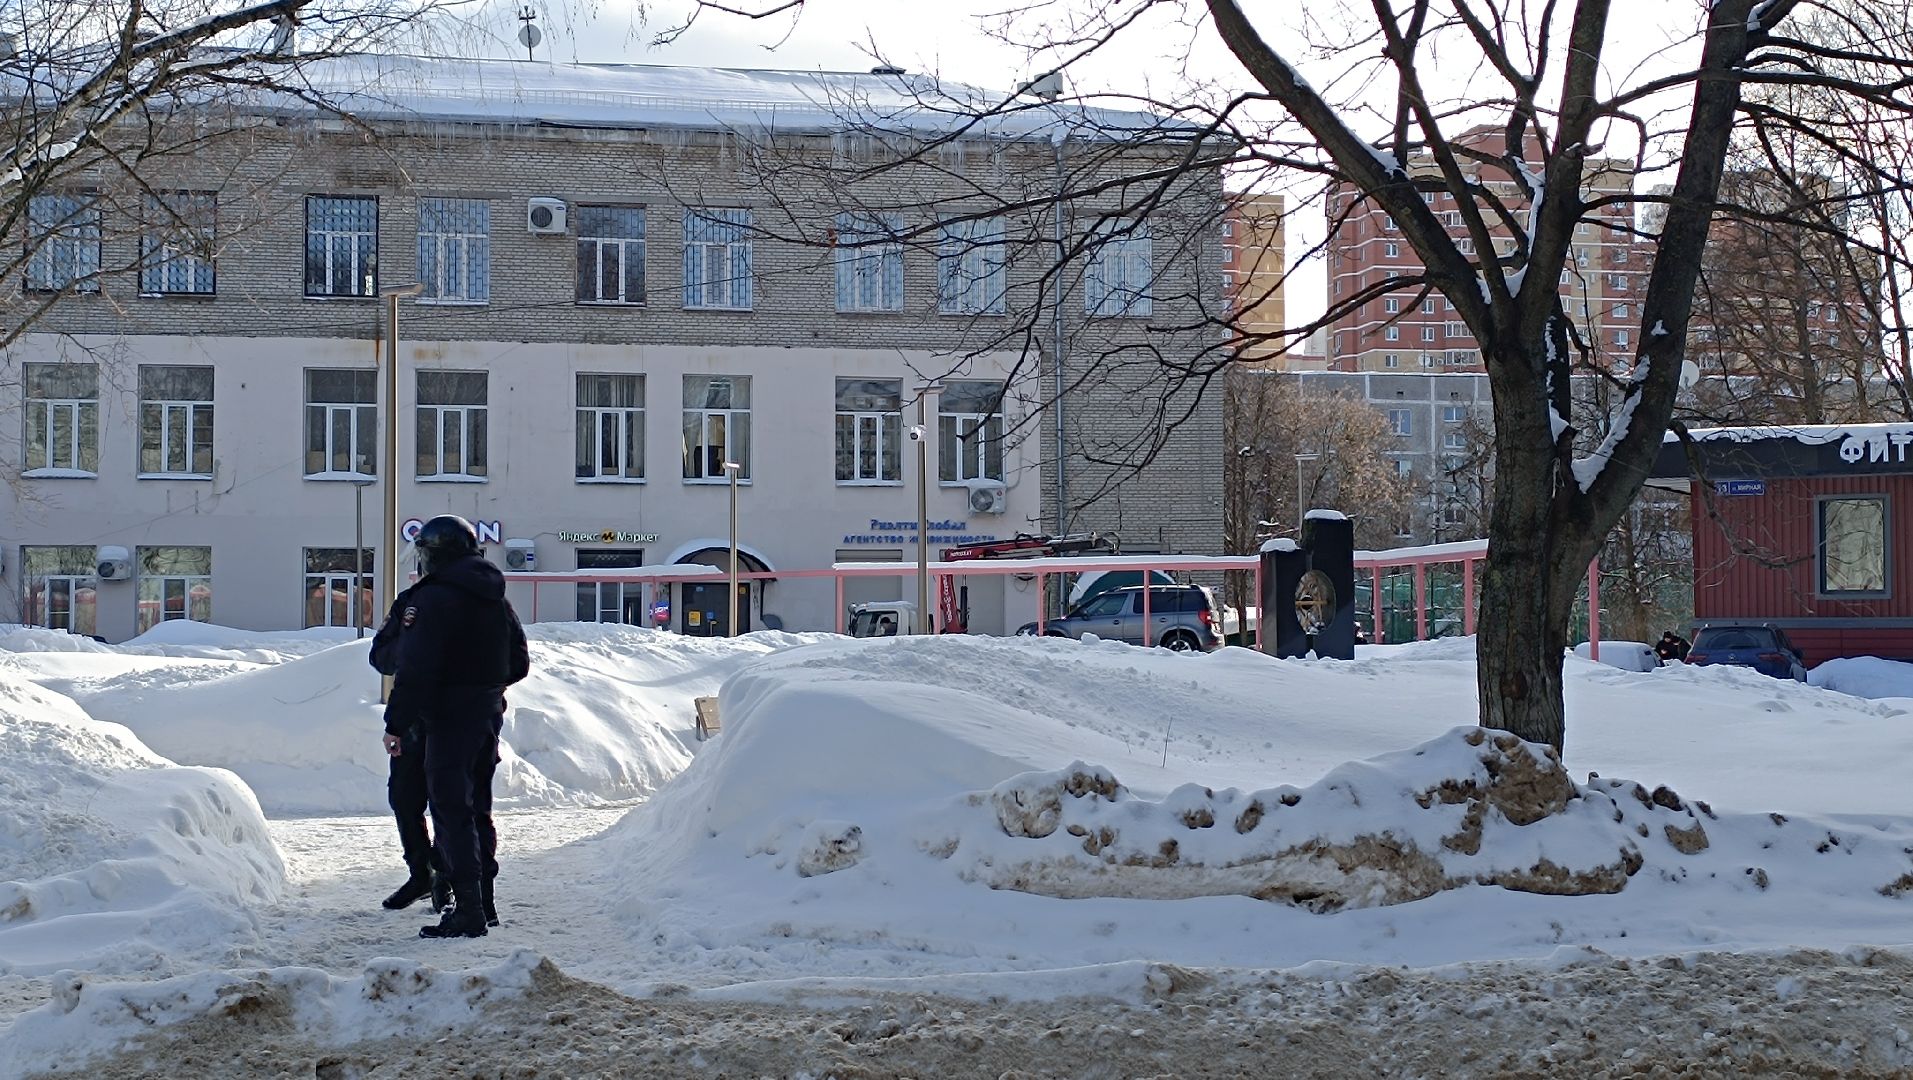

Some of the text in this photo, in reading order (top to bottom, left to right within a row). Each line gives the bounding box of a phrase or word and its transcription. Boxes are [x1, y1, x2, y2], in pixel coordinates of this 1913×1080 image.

[1840, 434, 1913, 464] ФИТ
[401, 518, 502, 544] ON
[925, 519, 966, 531] лобал
[559, 530, 659, 544] Яндекс Маркет
[843, 535, 995, 545] АГЕНТСТВО НВИЖИМОСТИ
